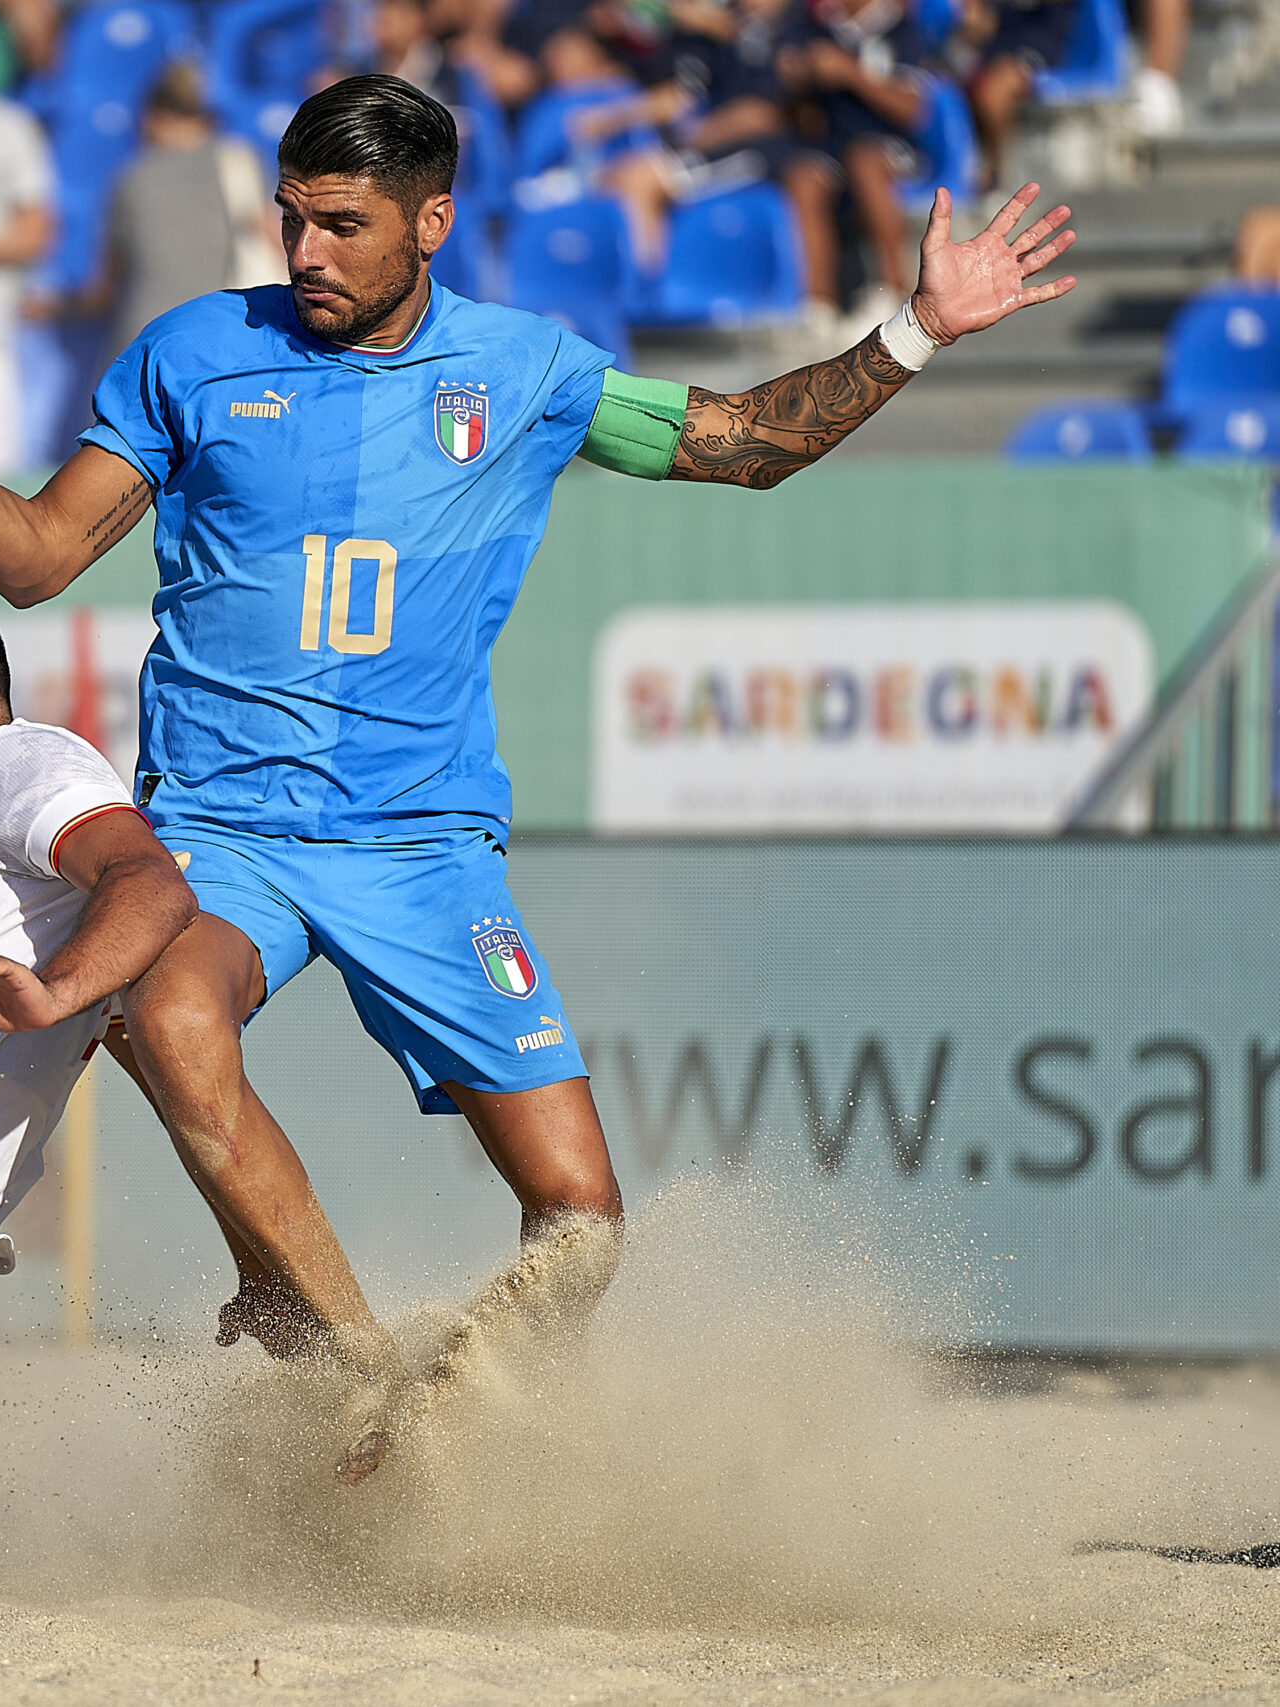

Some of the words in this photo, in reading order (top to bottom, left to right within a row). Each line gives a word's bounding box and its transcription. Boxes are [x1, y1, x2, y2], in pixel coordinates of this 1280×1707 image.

[230, 401, 282, 419] PUMA
[439, 395, 483, 411] ITALIA
[299, 534, 398, 655] 10
[624, 663, 1120, 744] SARDEGNA
[479, 933, 519, 950] ITALIA
[515, 1028, 563, 1054] PUMA
[458, 1030, 1280, 1181] ww.sar
